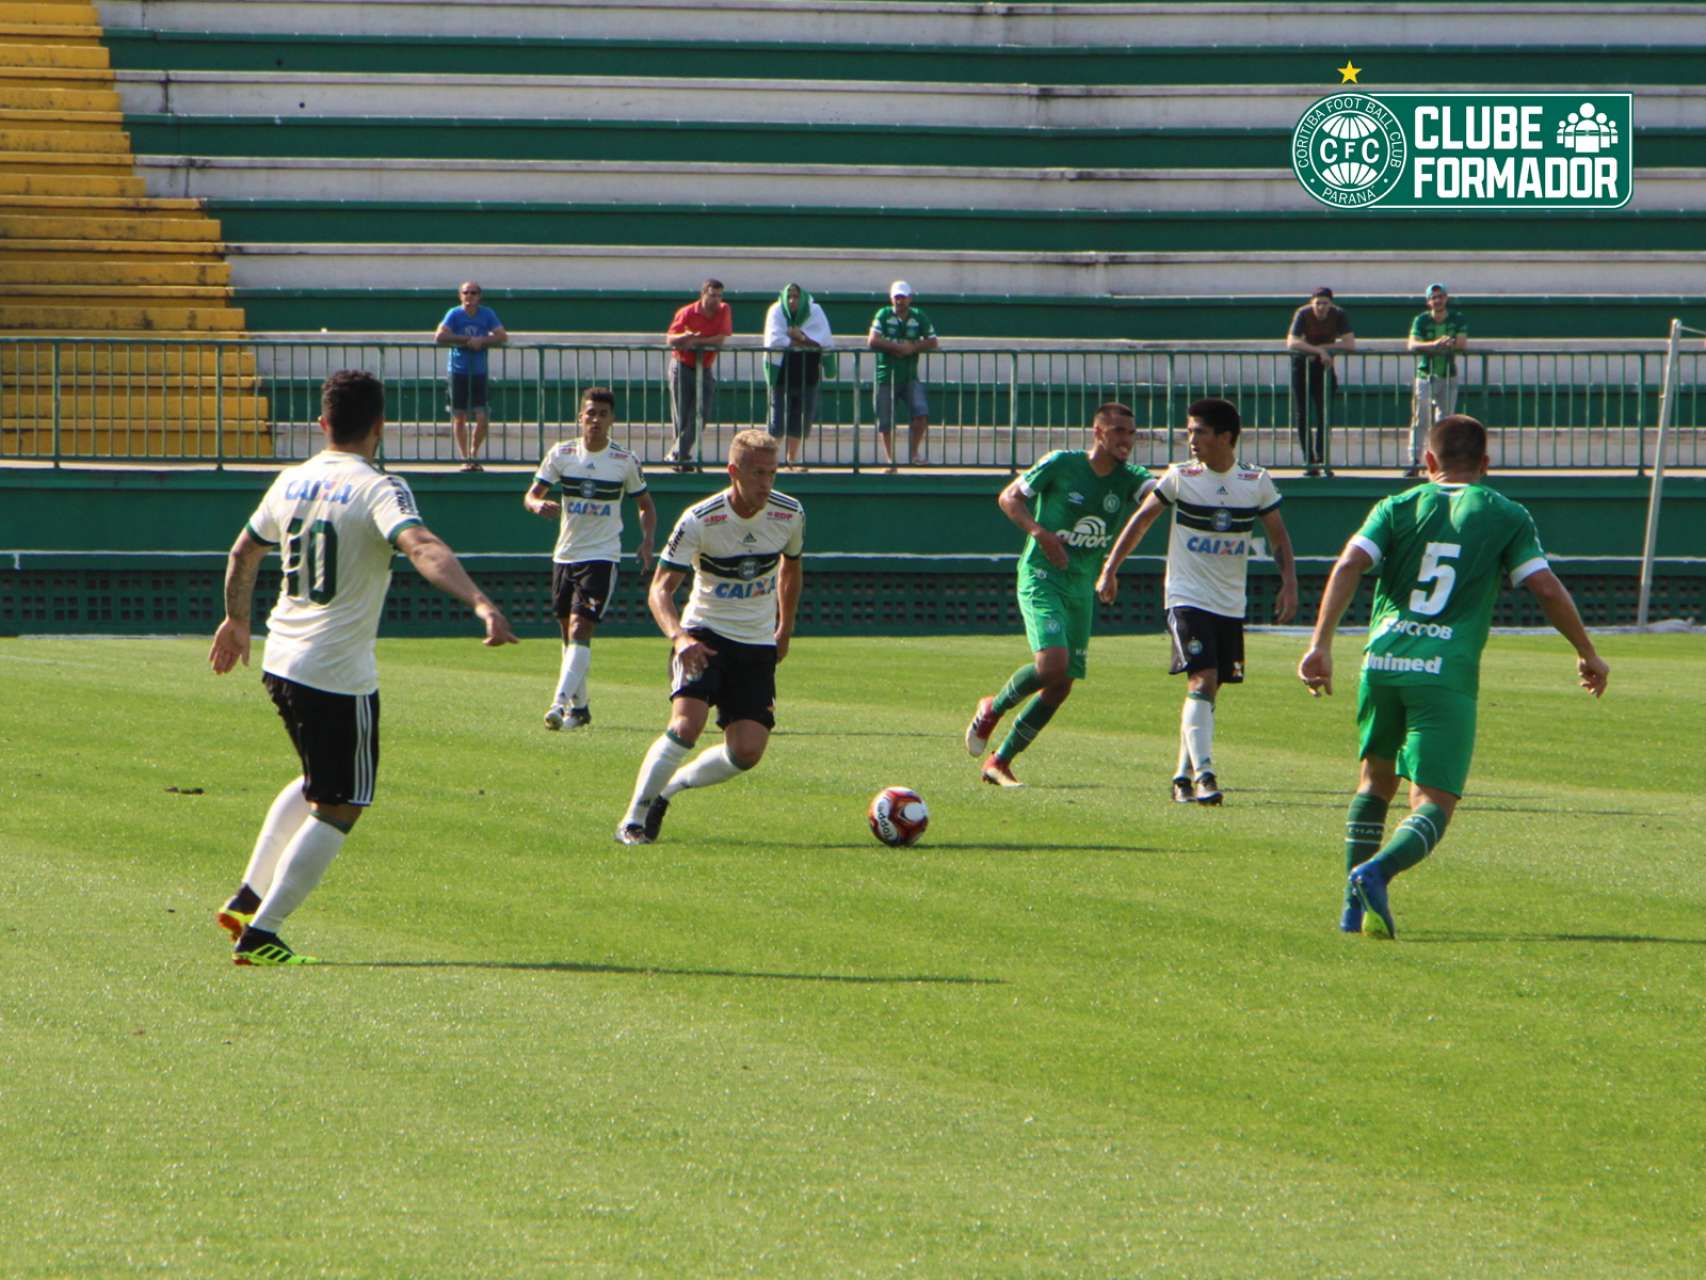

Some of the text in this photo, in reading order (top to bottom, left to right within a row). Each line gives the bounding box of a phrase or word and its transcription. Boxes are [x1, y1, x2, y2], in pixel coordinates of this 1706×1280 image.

[567, 502, 611, 516] CAIXA
[1187, 536, 1246, 555] CAIXA
[286, 518, 337, 605] 10
[1408, 541, 1462, 616] 5
[1368, 652, 1443, 675] nimed
